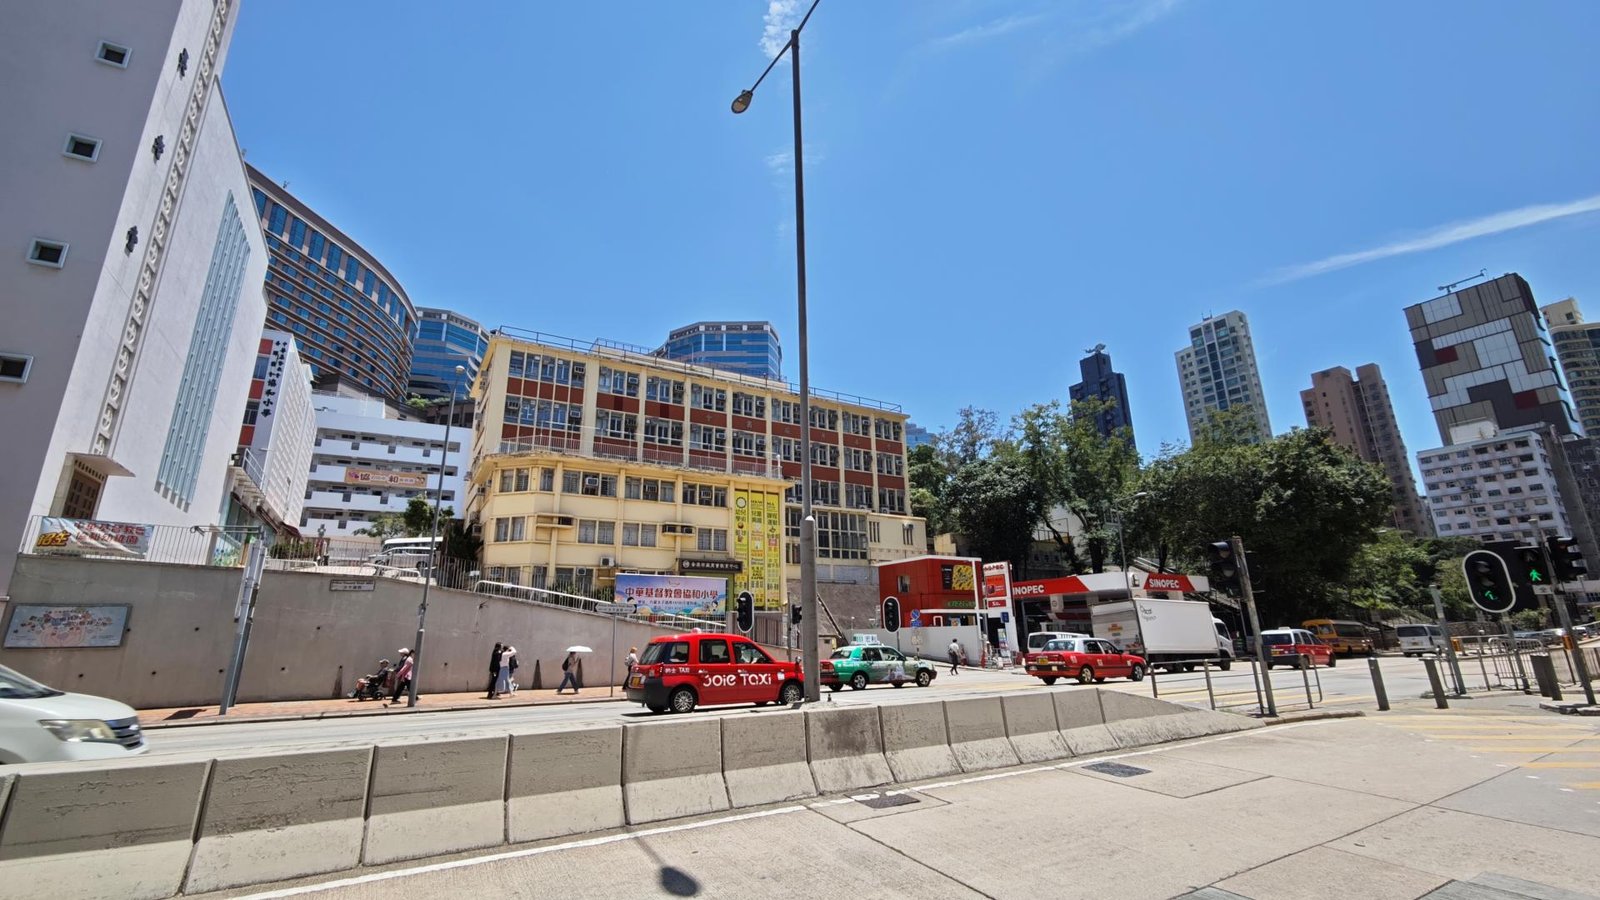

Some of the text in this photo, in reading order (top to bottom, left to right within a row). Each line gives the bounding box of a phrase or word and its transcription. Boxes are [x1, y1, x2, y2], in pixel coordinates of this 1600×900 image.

[1149, 578, 1180, 589] SINOPEC
[625, 587, 719, 600] 中華基督教會協和小學
[1012, 584, 1045, 595] INOPEC
